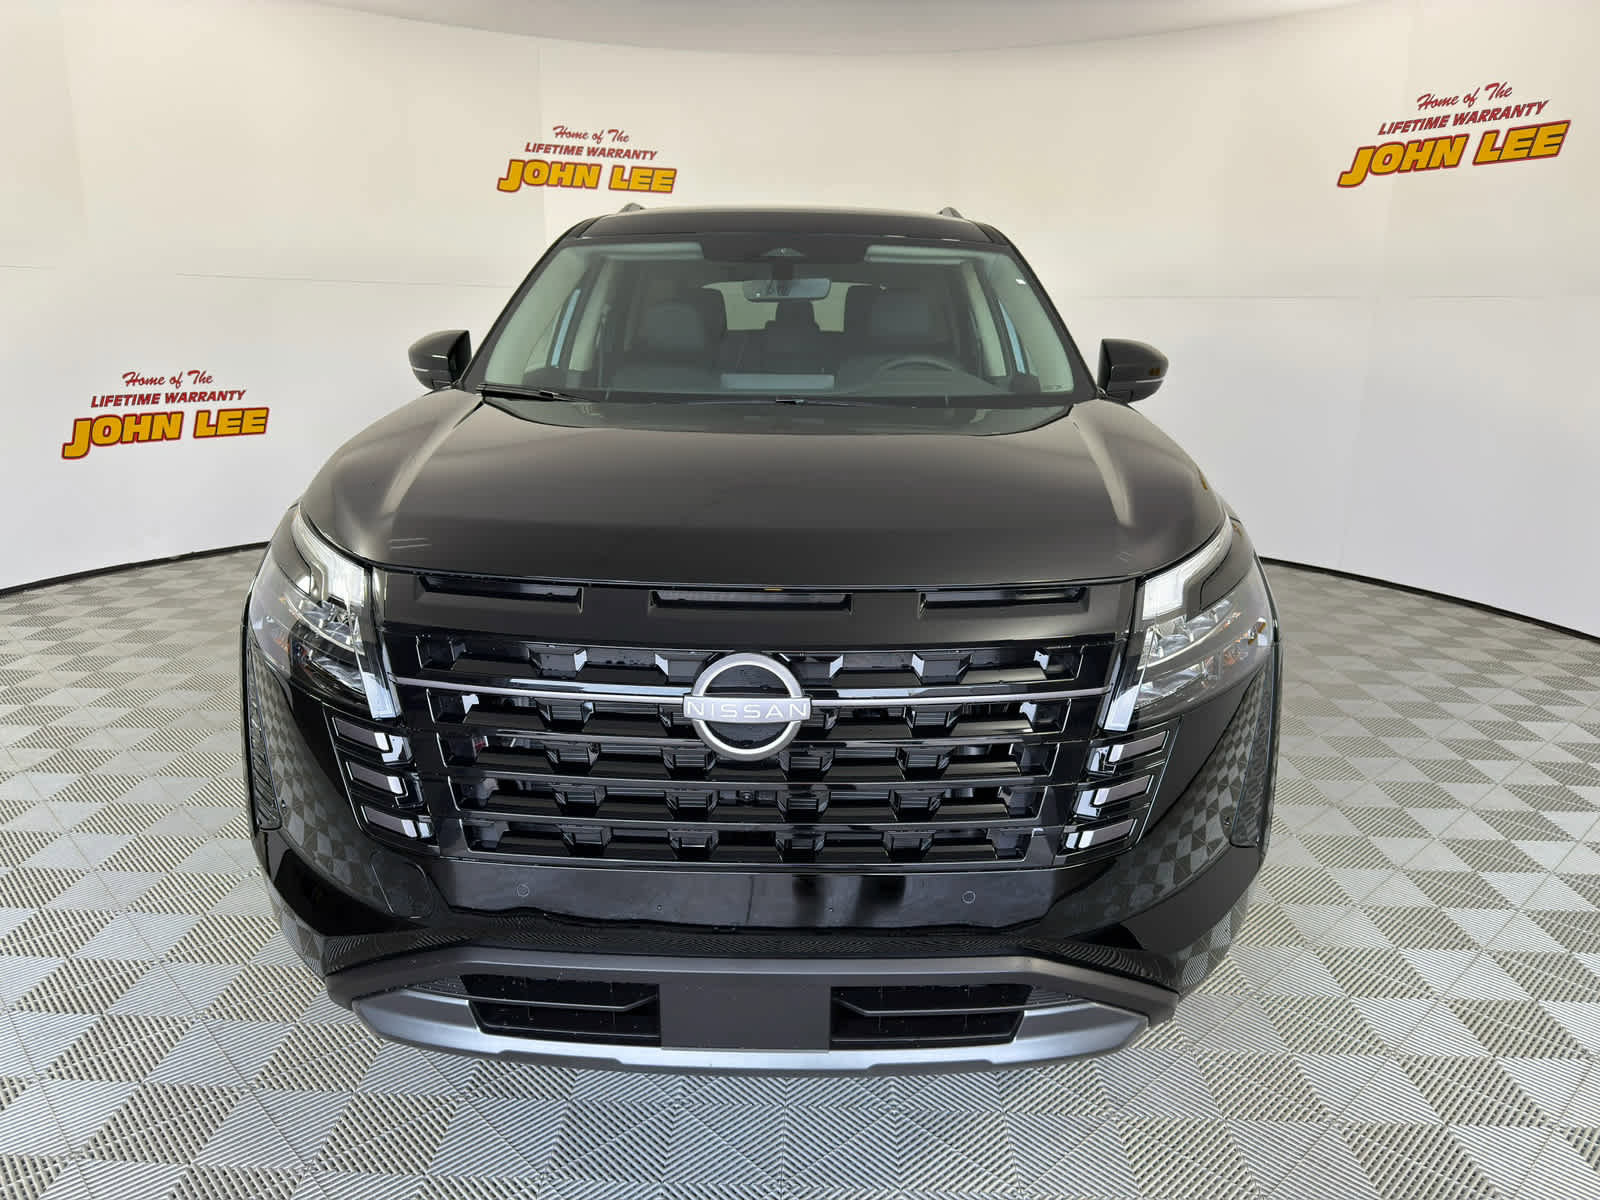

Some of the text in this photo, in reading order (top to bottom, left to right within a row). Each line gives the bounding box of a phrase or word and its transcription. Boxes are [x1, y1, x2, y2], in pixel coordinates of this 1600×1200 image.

[1416, 81, 1513, 111] Home of The
[1378, 100, 1550, 136] LIFETIME WARRANTY
[552, 125, 630, 144] Home of The
[524, 142, 658, 161] LIFETIME WARRANTY
[1337, 119, 1572, 188] JOHN LEE
[497, 159, 677, 194] JOHN LEE
[122, 369, 214, 389] Home of The
[91, 389, 247, 408] LIFETIME WARRANTY
[61, 407, 269, 460] JOHN LEE
[686, 700, 807, 719] NISSAN
